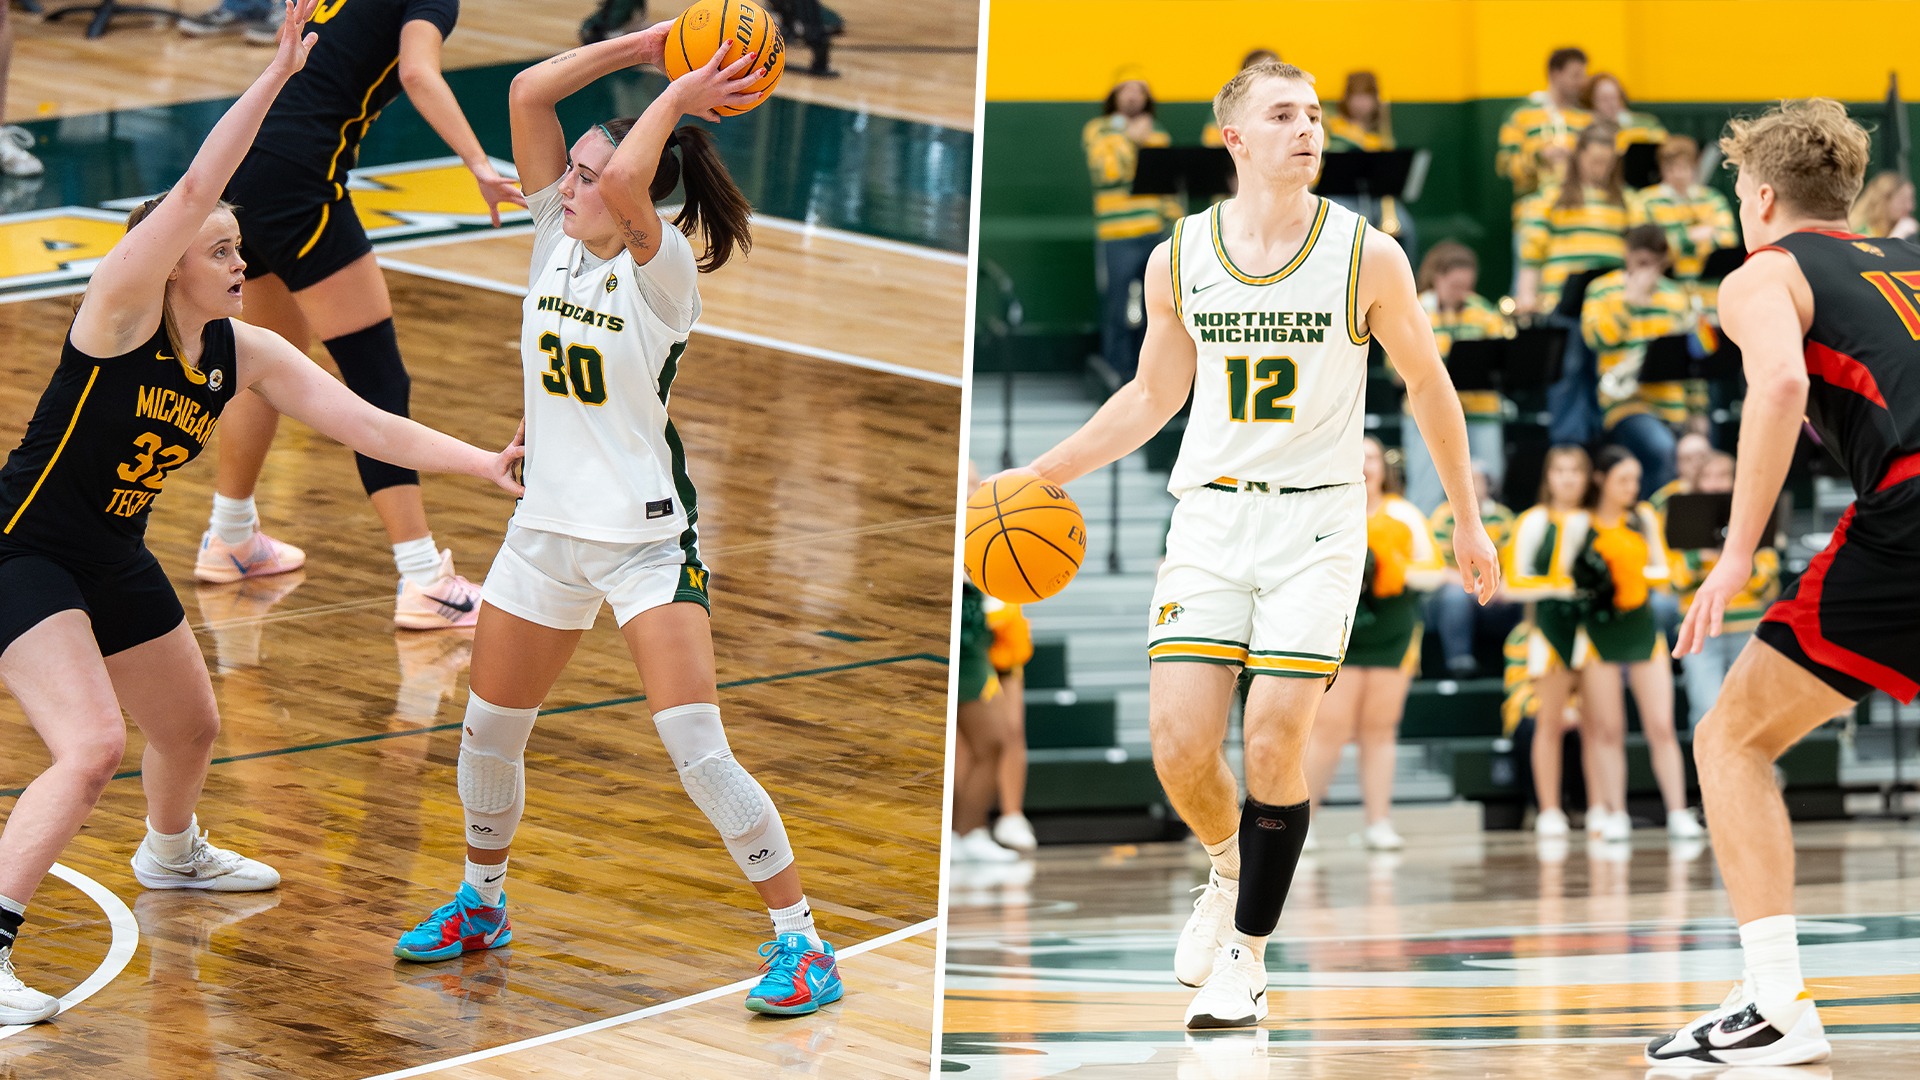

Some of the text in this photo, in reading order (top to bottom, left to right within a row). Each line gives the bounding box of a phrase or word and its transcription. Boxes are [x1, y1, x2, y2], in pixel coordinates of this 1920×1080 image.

[537, 295, 625, 332] WILDCATS
[1193, 311, 1332, 328] NORTHERN
[1200, 328, 1325, 343] MICHIGAN
[538, 330, 609, 407] 30
[1224, 356, 1298, 423] 12
[135, 384, 219, 447] MICHIGAN
[116, 431, 189, 490] 32
[105, 488, 156, 518] TECH
[1067, 525, 1087, 552] EV
[686, 566, 706, 592] N
